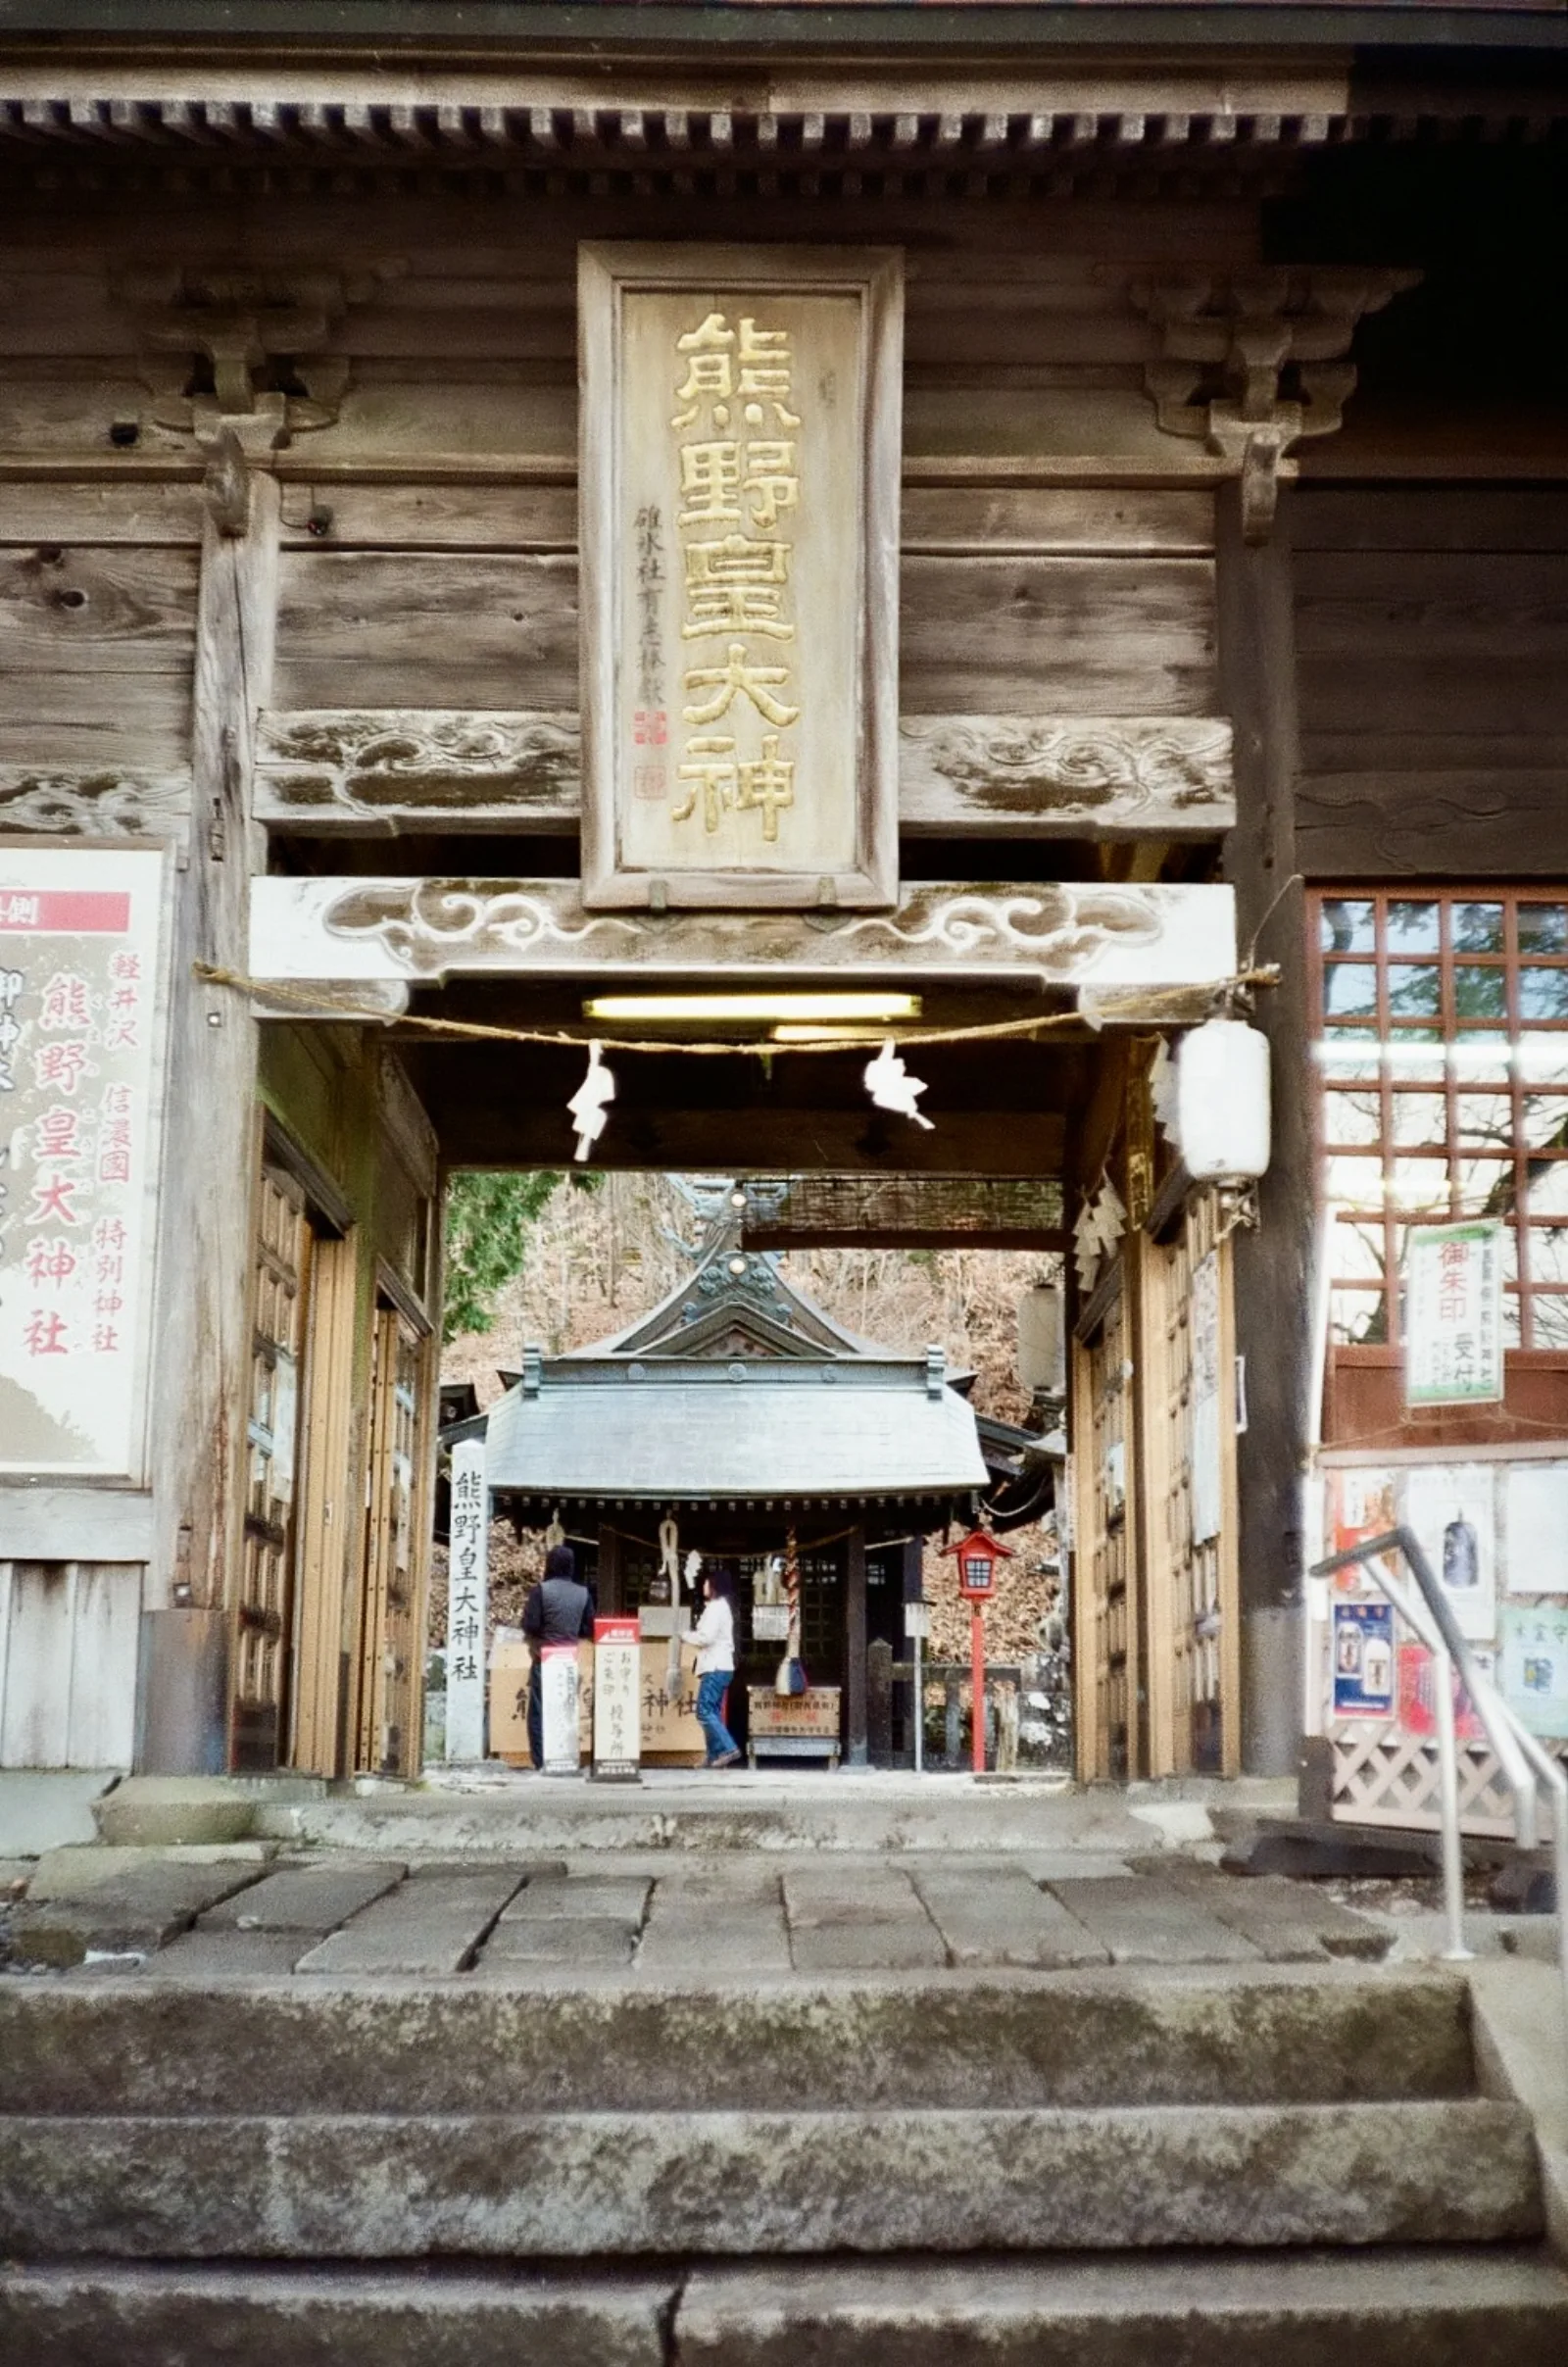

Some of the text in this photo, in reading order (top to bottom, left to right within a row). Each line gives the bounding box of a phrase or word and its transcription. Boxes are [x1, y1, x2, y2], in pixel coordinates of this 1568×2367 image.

[670, 313, 802, 843] 熊野皇大神
[109, 953, 141, 1047] 軽井沢
[23, 977, 94, 1357] 熊野皇大神社
[91, 1217, 128, 1354] 特別神社
[450, 1470, 482, 1682] 熊野皇大神社
